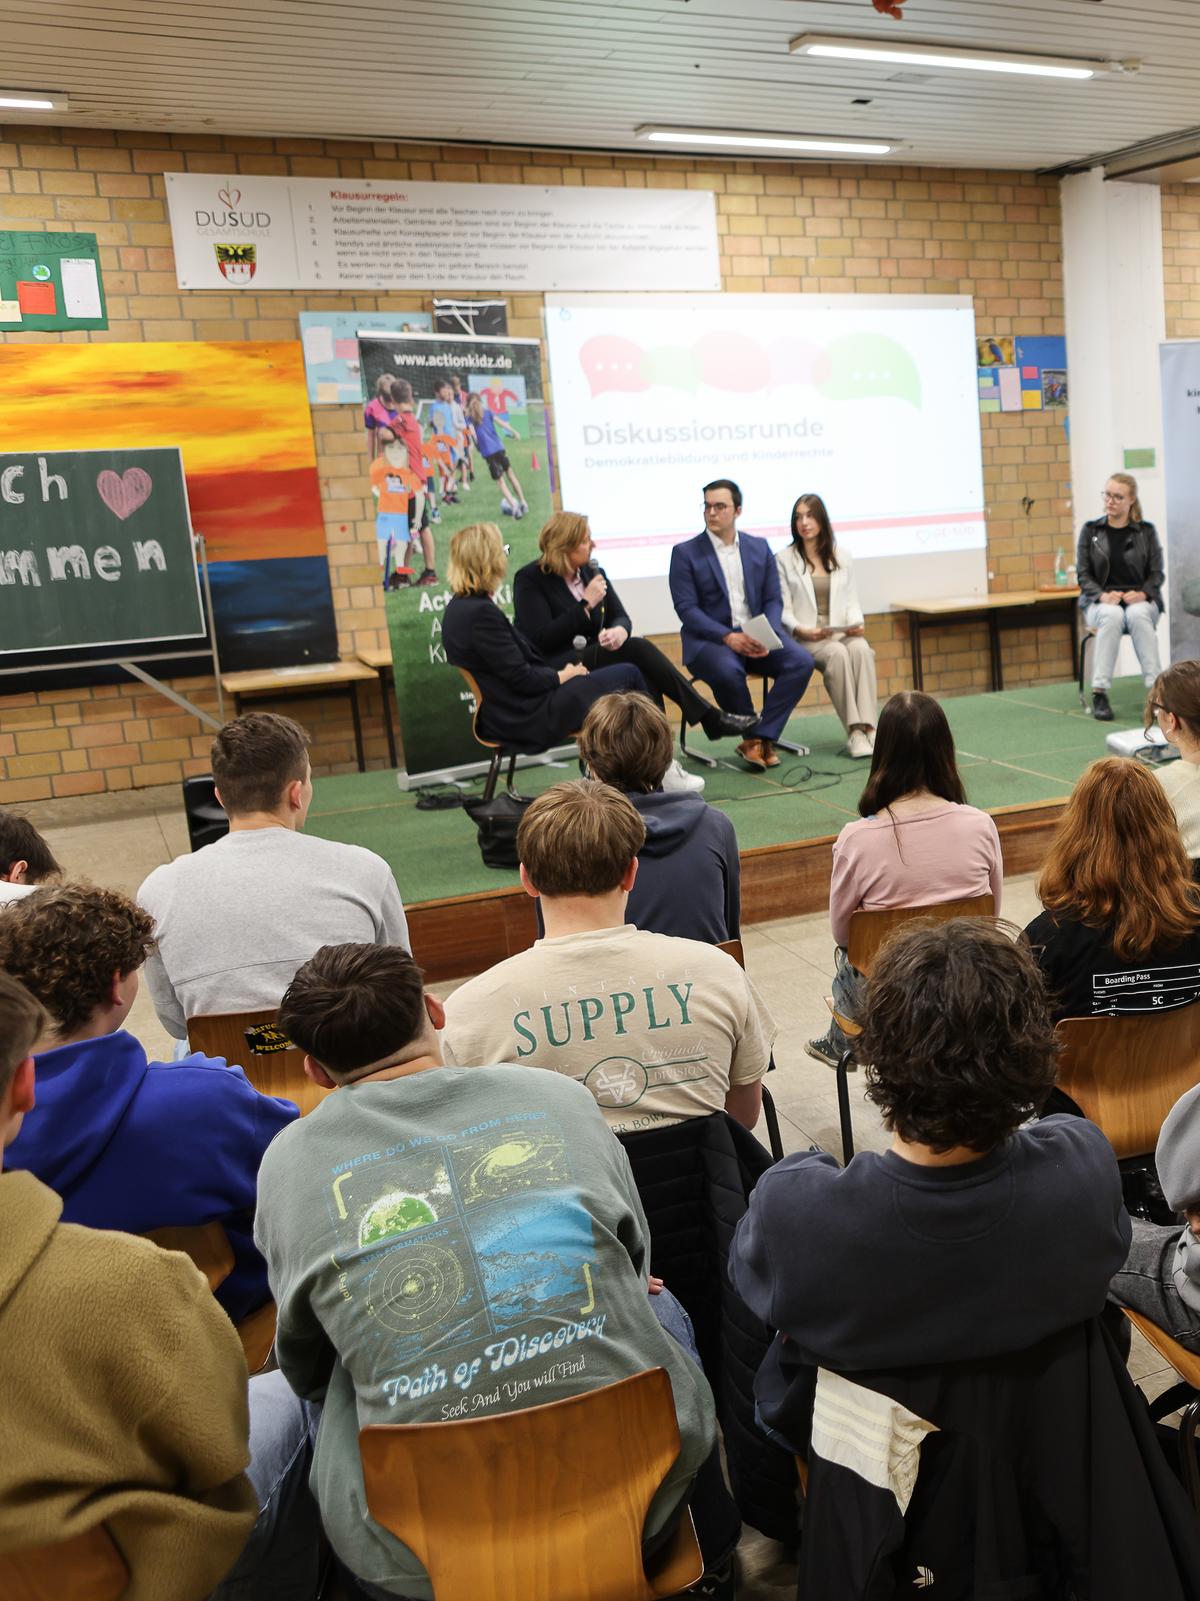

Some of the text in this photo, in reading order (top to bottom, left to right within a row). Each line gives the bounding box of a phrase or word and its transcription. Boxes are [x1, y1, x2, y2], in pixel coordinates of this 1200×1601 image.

[393, 353, 513, 368] www.actionkidz.de
[582, 417, 824, 446] Diskussionsrunde
[584, 446, 834, 469] Demokratiebildung und Kinderrechte
[1105, 973, 1150, 985] Boarding Pass
[1152, 996, 1164, 1005] 5C
[512, 982, 694, 1058] SUPPLY
[331, 1151, 381, 1176] WHERE
[384, 1142, 405, 1157] DO
[409, 1134, 433, 1148] WE
[461, 1117, 502, 1138] FROM
[382, 1362, 448, 1407] Path
[453, 1357, 482, 1390] of
[484, 1314, 607, 1372] Discovery
[440, 1354, 586, 1422] Seek And You will Find
